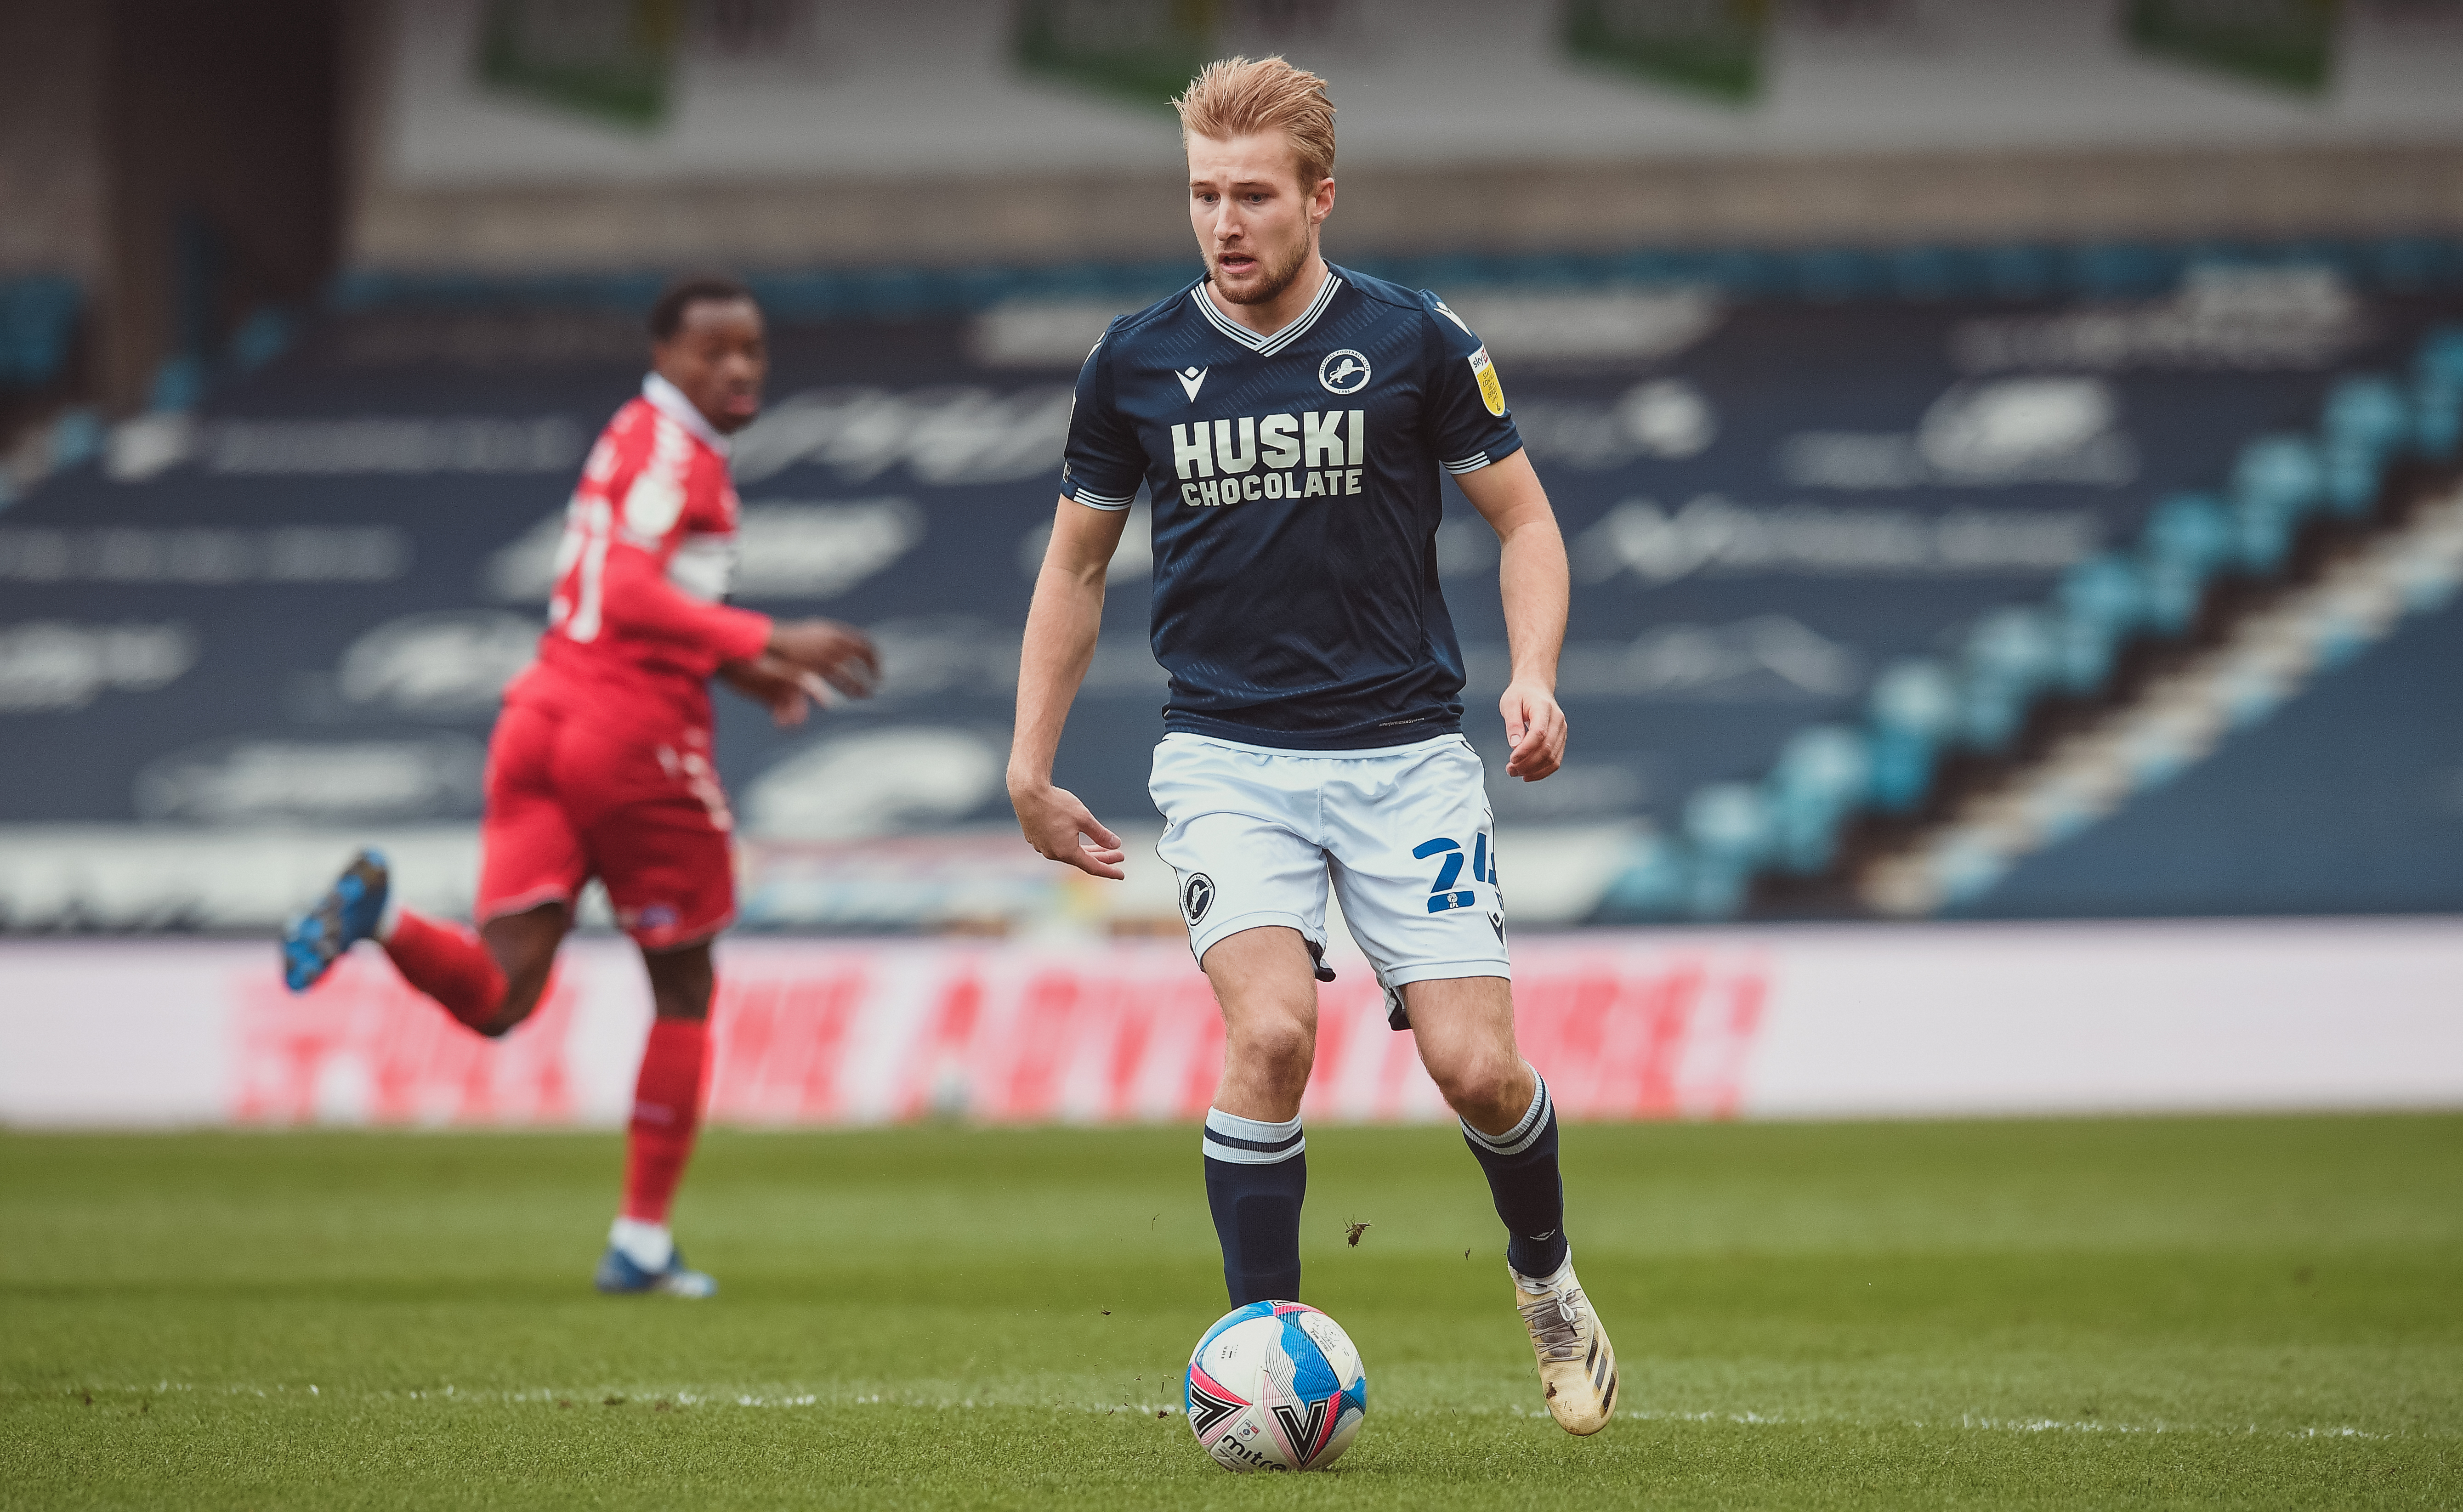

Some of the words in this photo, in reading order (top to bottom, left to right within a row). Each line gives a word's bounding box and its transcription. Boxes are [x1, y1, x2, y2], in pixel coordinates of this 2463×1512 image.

[1320, 353, 1335, 374] MILLWALL
[1337, 350, 1362, 359] FOOTBALL
[1473, 356, 1483, 368] sky
[1171, 410, 1364, 479] HUSKI
[1181, 469, 1362, 506] CHOCOLATE
